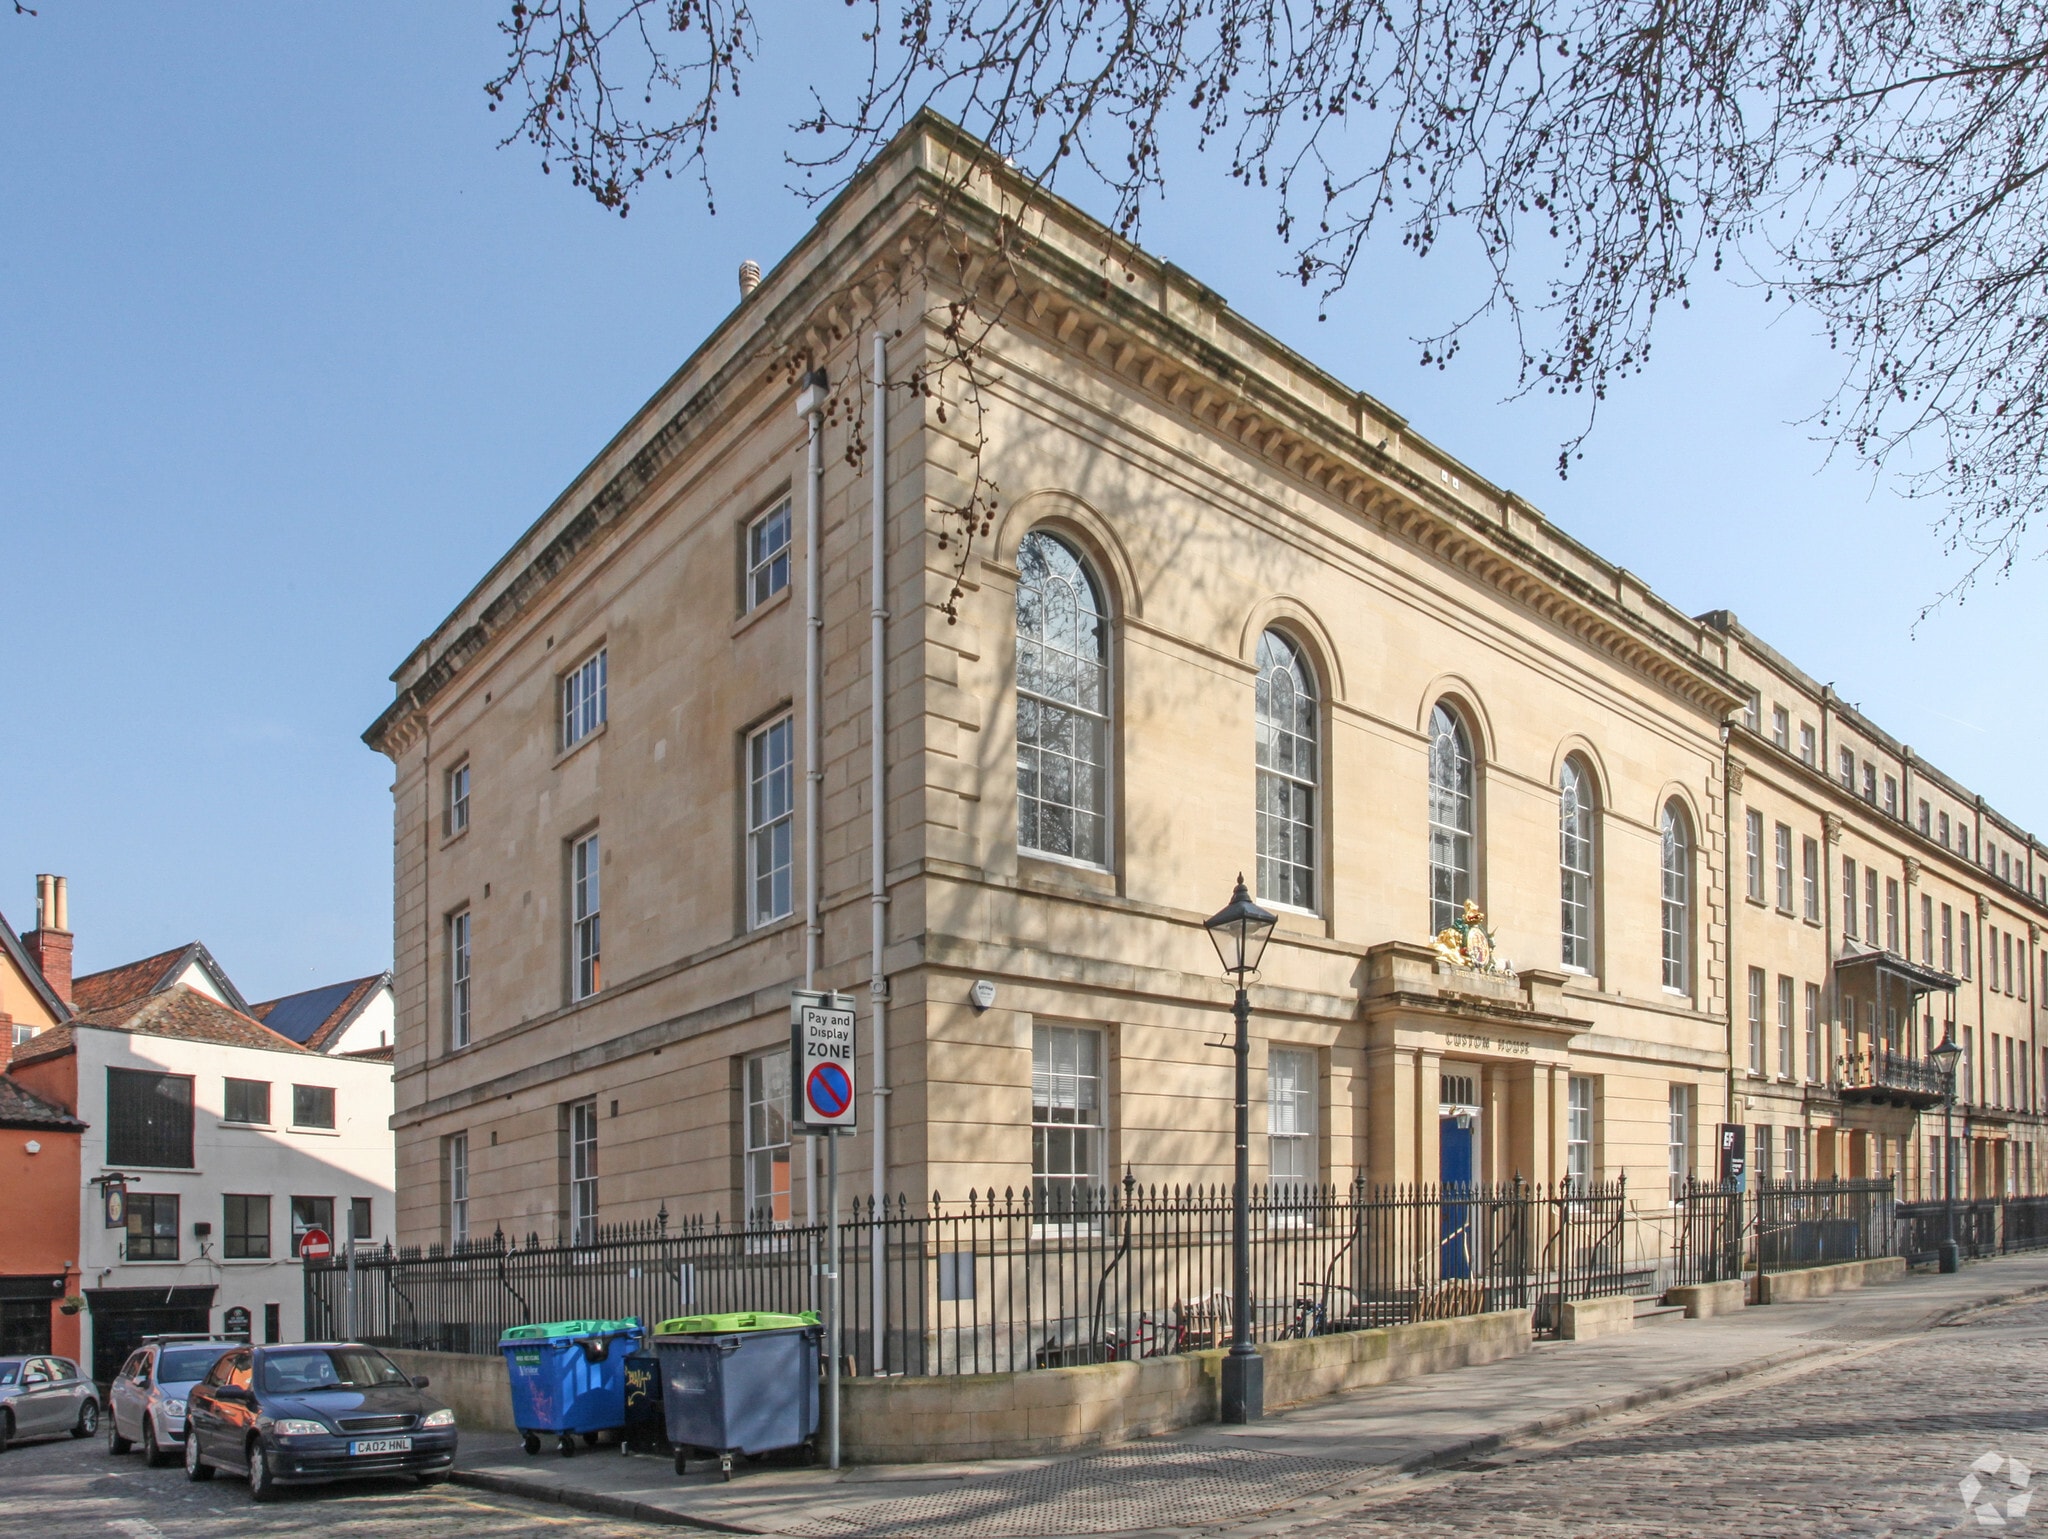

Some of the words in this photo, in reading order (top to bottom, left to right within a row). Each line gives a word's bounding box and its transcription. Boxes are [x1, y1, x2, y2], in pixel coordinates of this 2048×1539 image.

[808, 1011, 828, 1026] Pay
[831, 1016, 850, 1026] and
[810, 1026, 849, 1042] Display
[808, 1042, 850, 1059] ZONE
[1446, 1031, 1490, 1050] CUSTOM
[1497, 1038, 1530, 1055] HOUSE
[1723, 1131, 1734, 1147] EF
[358, 1441, 387, 1453] CA02
[389, 1440, 409, 1450] HNL
